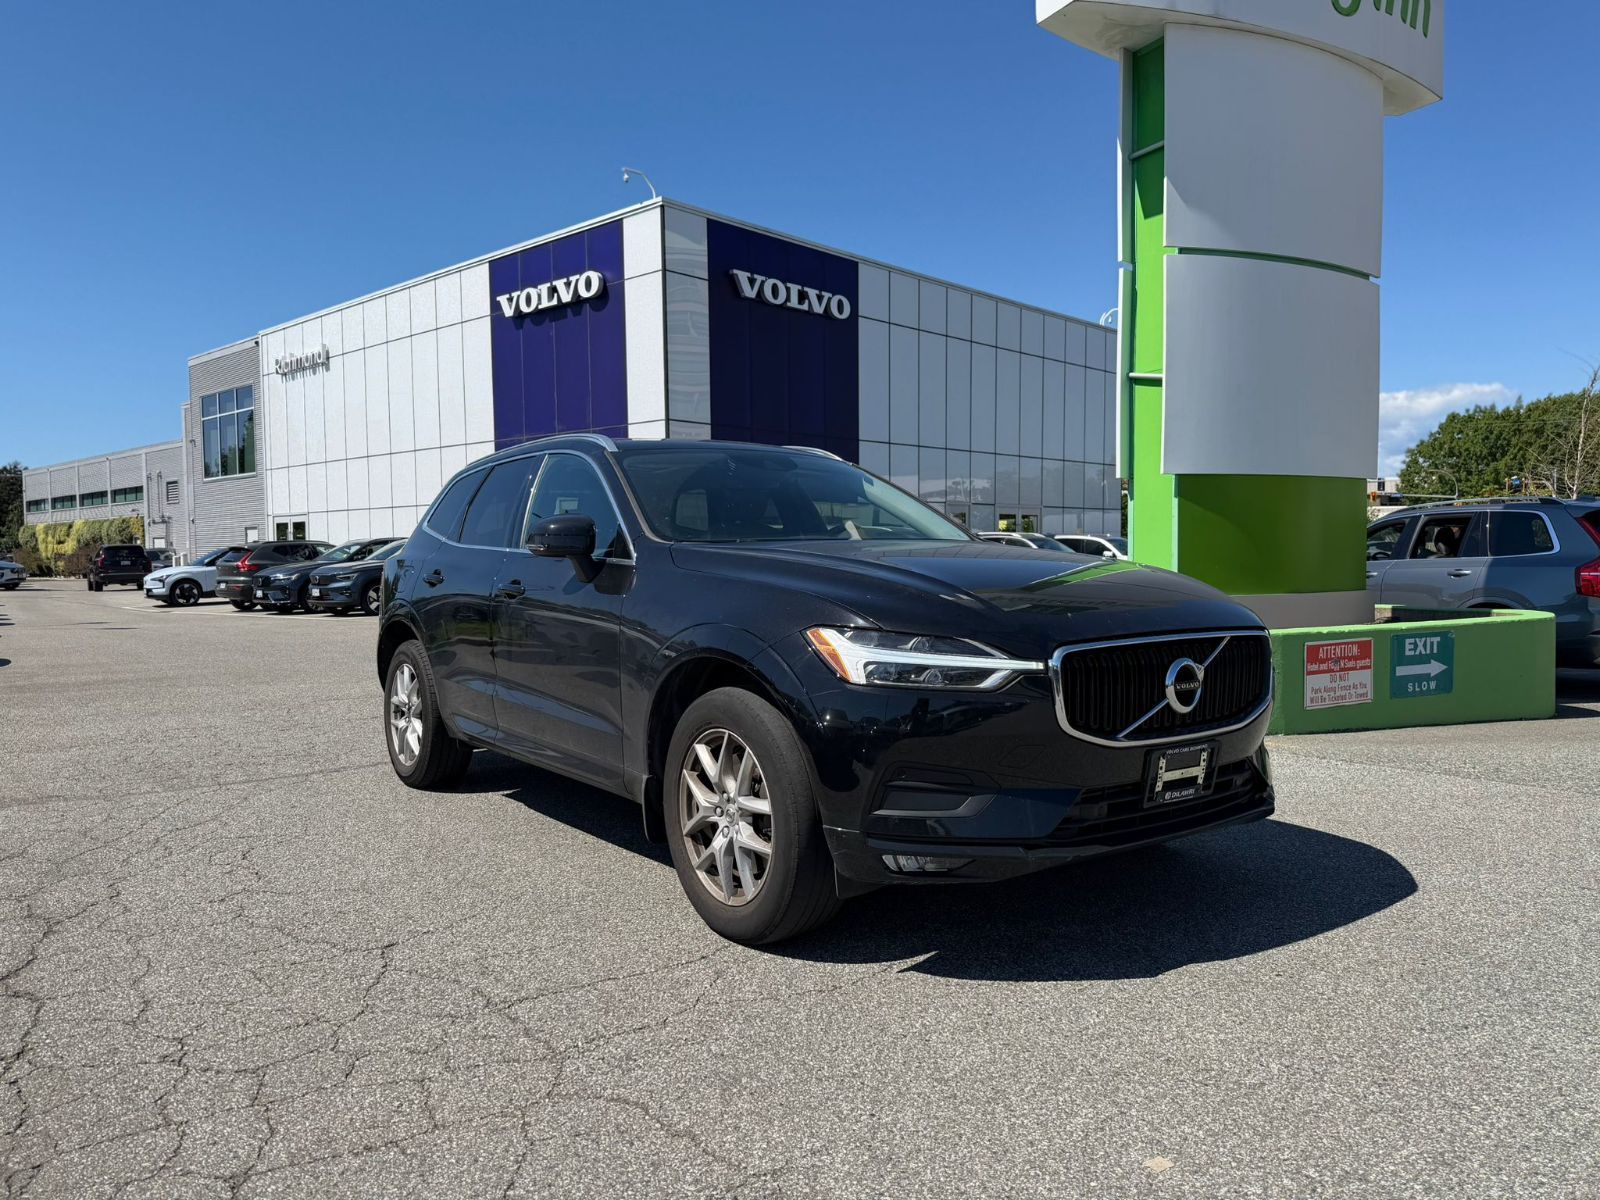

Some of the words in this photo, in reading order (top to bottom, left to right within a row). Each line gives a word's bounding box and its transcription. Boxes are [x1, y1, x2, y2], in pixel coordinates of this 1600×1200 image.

[497, 270, 604, 318] VOLVO
[730, 268, 851, 320] VOLVO
[1319, 644, 1361, 659] ATTENTION:
[1405, 637, 1441, 656] EXIT
[1330, 673, 1338, 683] DO
[1339, 671, 1349, 682] NOT
[1175, 681, 1200, 689] VOLVO
[1311, 685, 1322, 695] Park
[1323, 684, 1337, 695] Along
[1338, 683, 1351, 692] Fence
[1359, 681, 1367, 689] You
[1407, 680, 1437, 692] SLOW
